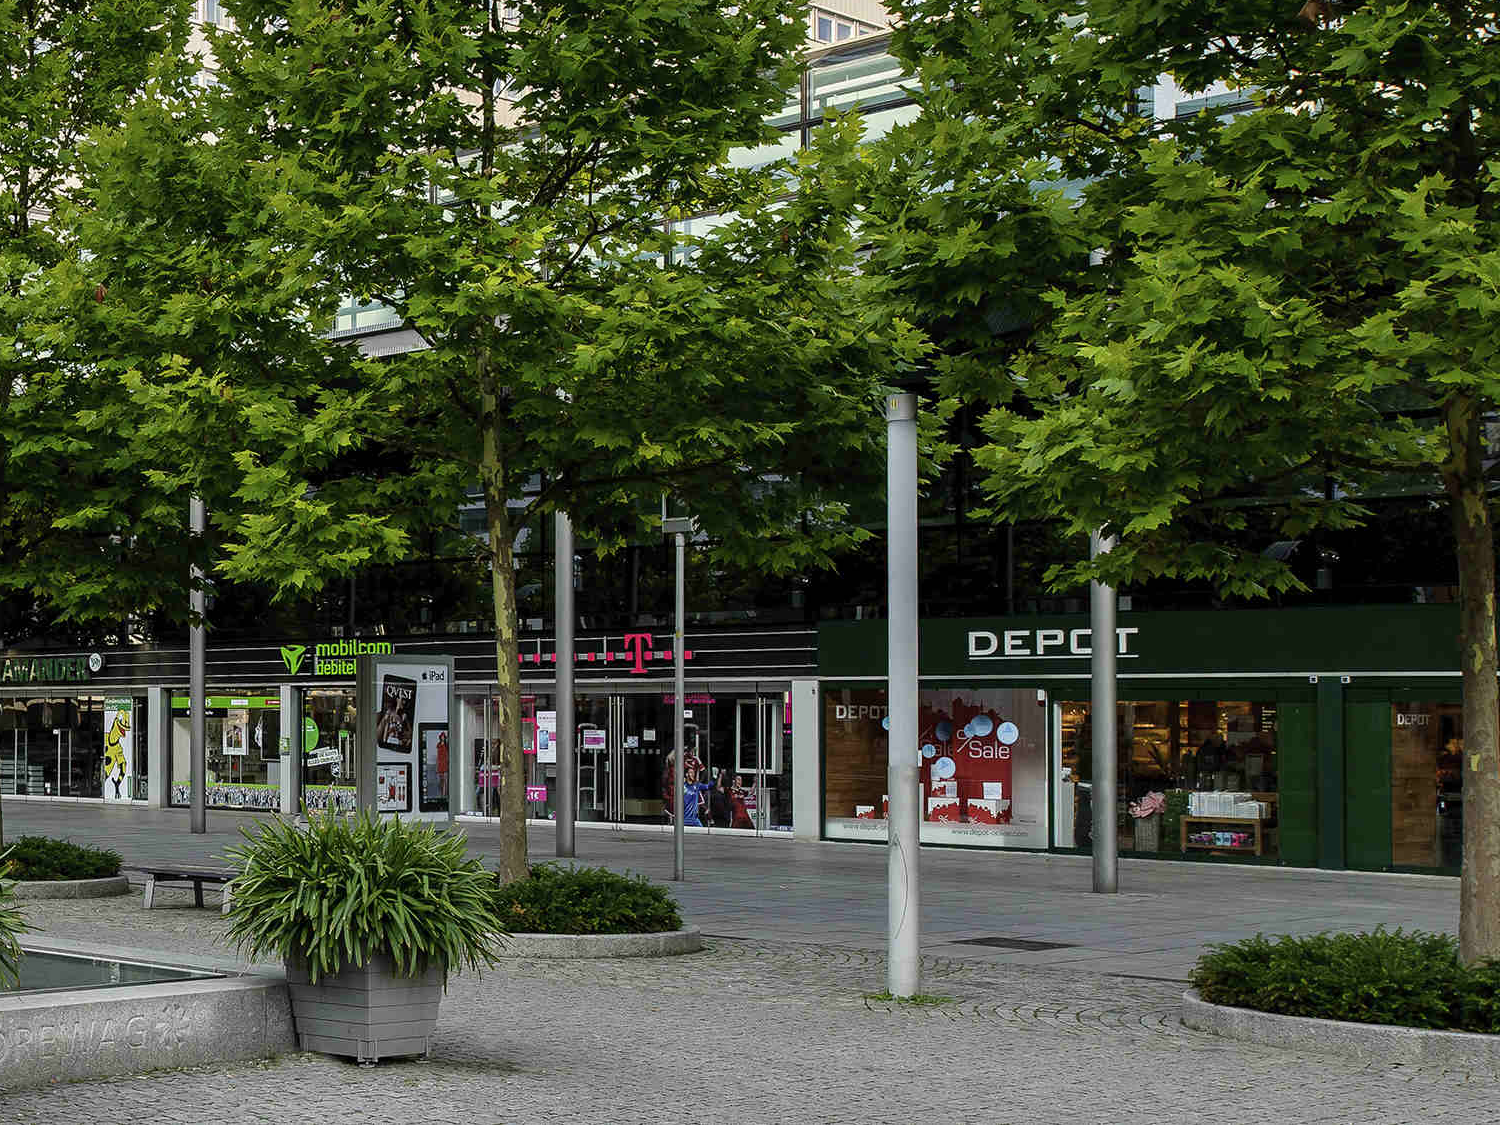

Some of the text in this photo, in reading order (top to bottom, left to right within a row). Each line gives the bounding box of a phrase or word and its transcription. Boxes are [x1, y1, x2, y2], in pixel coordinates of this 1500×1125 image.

[316, 639, 392, 656] mobilcom
[968, 628, 1139, 655] DEPOT
[429, 670, 445, 681] iPad
[1396, 713, 1431, 726] DEPOT
[968, 739, 1010, 759] Sale
